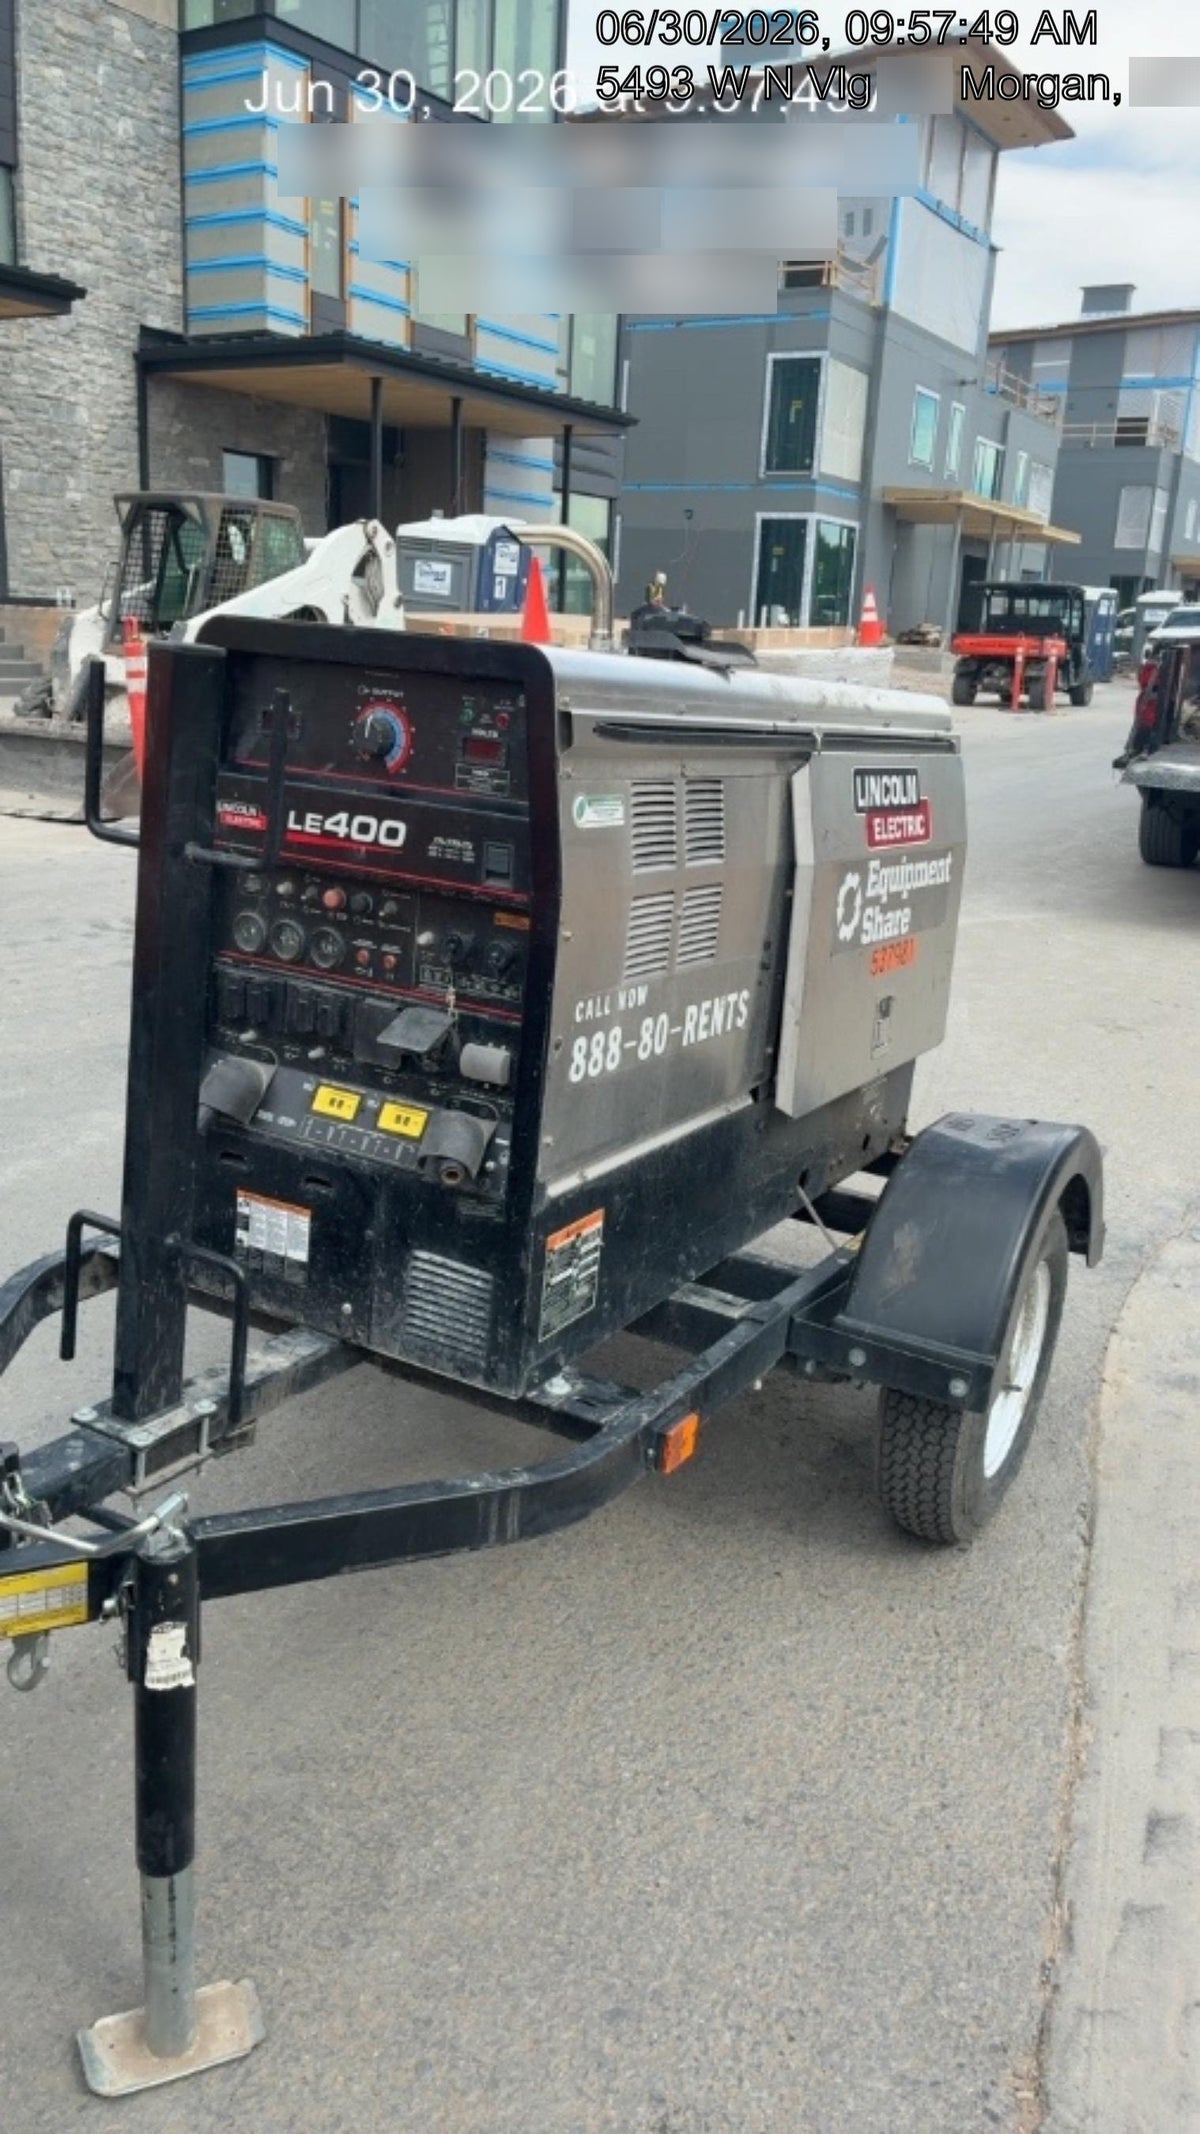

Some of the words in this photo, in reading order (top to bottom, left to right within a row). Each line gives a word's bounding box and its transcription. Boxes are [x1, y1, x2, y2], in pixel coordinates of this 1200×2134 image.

[855, 774, 918, 808] LINCOLN
[286, 810, 407, 848] LE400
[872, 814, 925, 841] ELECTRIC
[865, 850, 953, 904] Equipment
[860, 905, 912, 945] Share
[575, 995, 611, 1024] CALL
[618, 984, 649, 1011] NOW
[568, 988, 750, 1084] 888-80-RENTS
